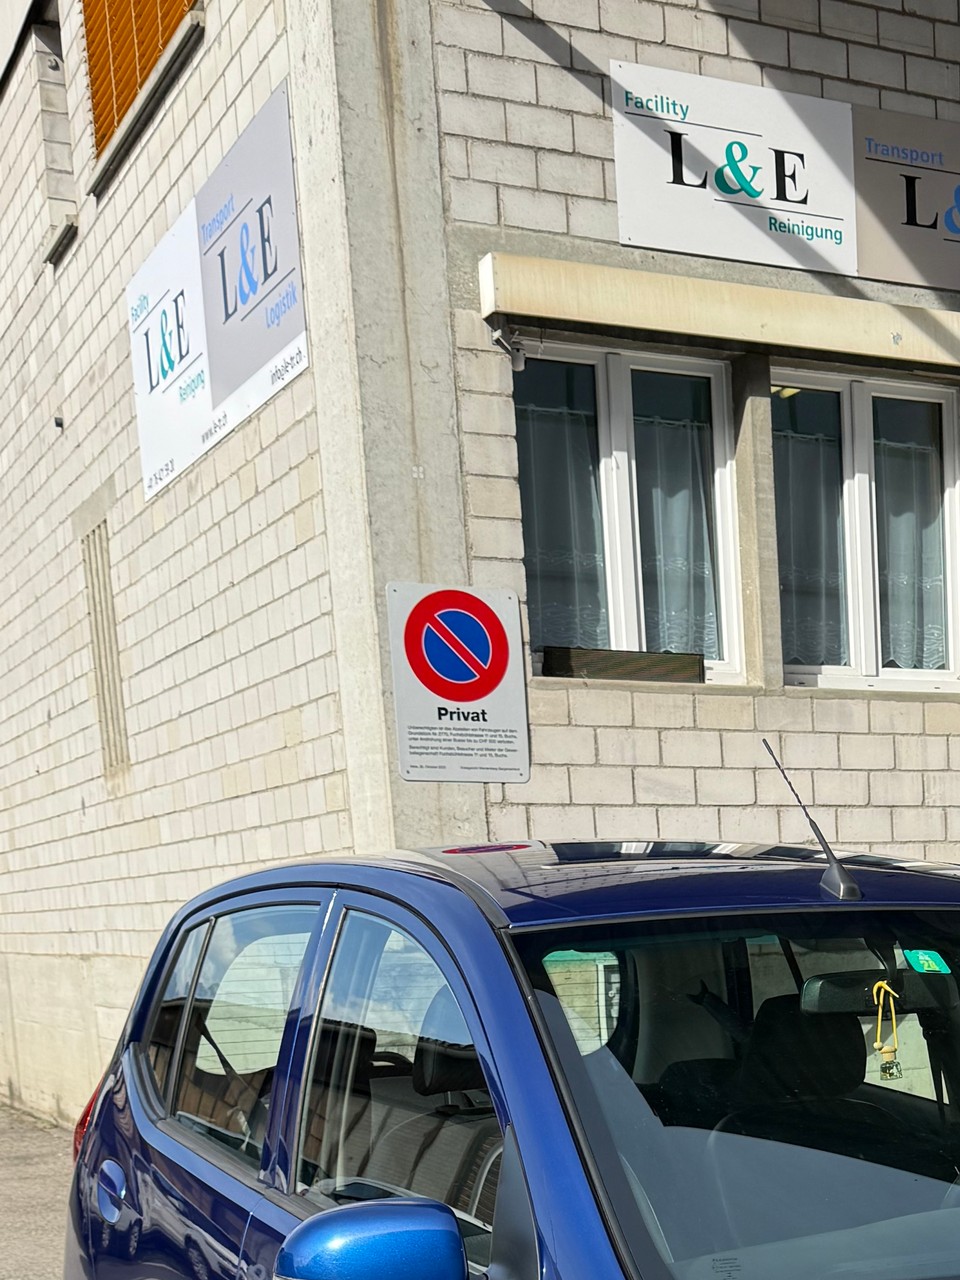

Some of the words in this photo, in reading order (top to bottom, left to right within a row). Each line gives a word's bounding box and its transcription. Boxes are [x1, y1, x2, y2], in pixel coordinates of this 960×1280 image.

[624, 90, 690, 122] Facility
[664, 129, 810, 206] L&E
[864, 137, 944, 167] Transport
[201, 193, 236, 245] Transport
[768, 216, 844, 246] Reinigung
[217, 194, 278, 325] L&E
[265, 280, 298, 329] Logistik
[437, 707, 488, 722] Privat
